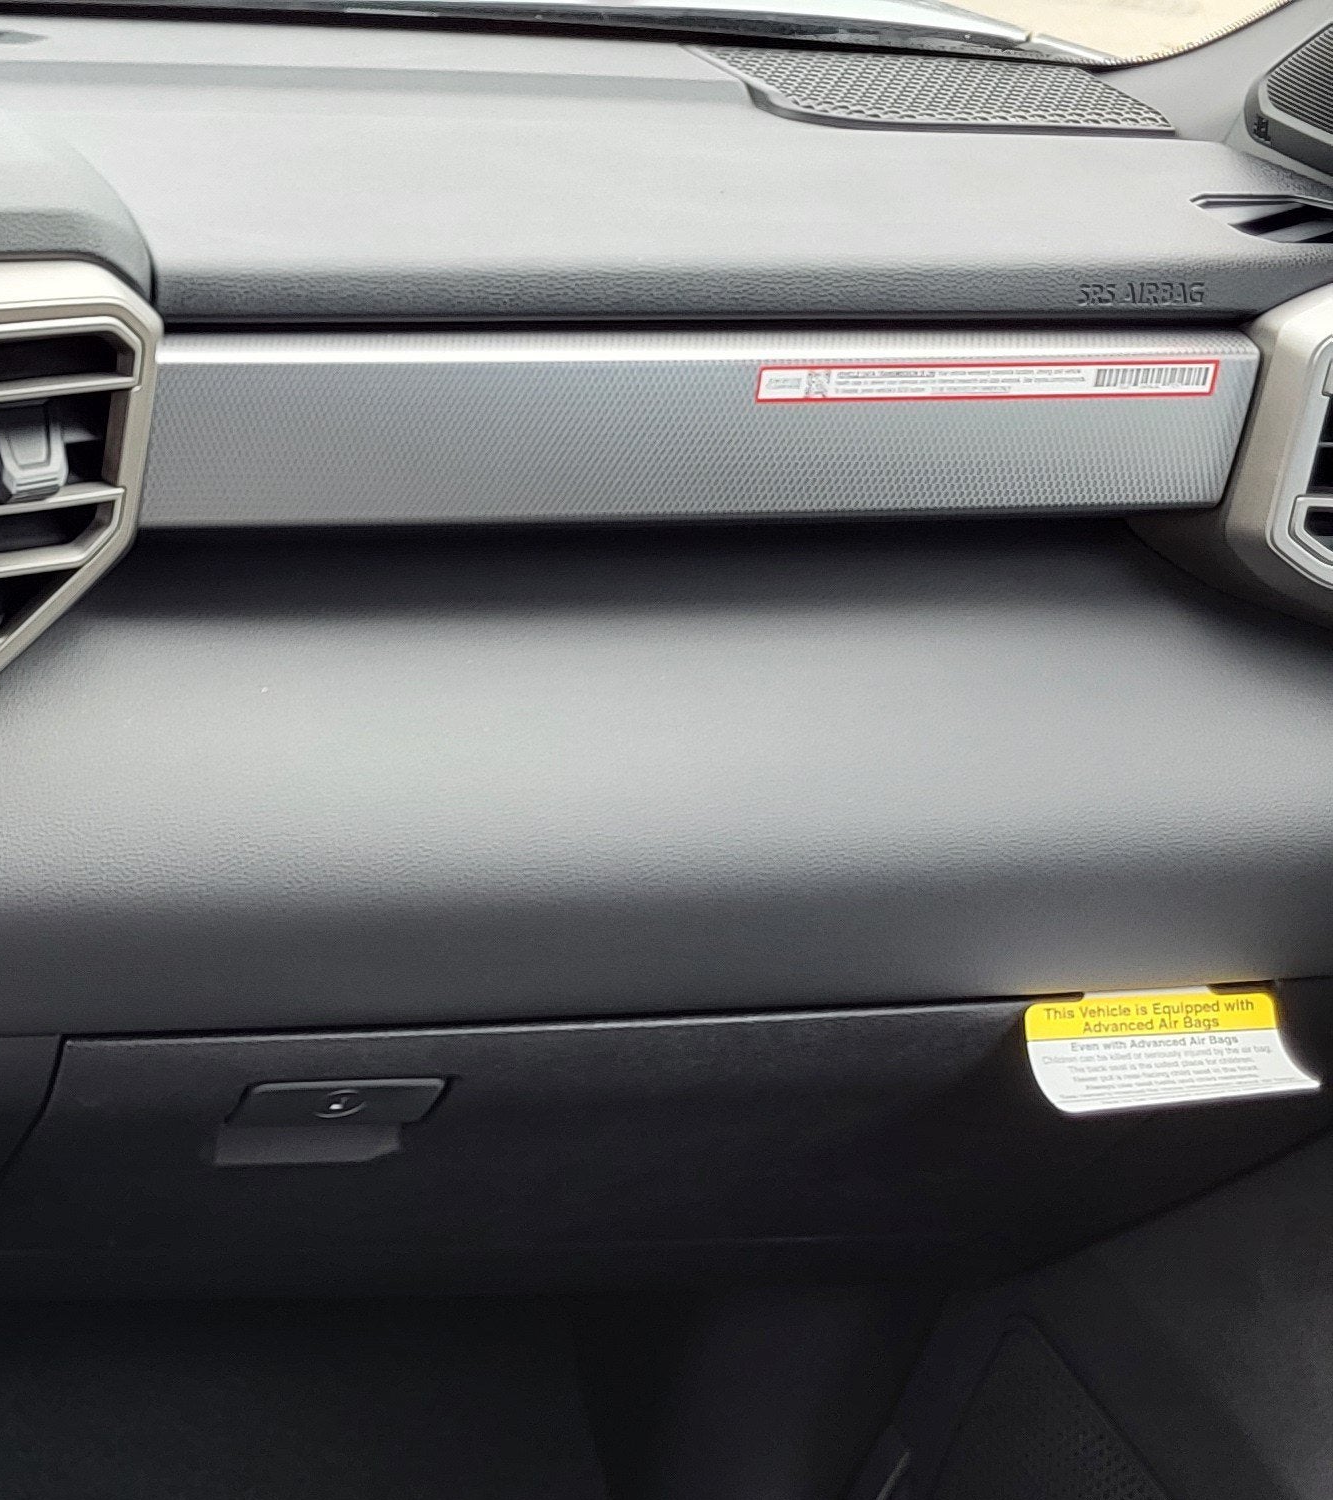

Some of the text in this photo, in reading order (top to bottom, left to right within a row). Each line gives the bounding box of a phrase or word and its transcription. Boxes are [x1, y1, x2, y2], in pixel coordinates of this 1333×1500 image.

[1078, 282, 1205, 306] SRS AIRBAG
[1044, 998, 1255, 1020] This Vehicle is Equipped with
[1082, 1015, 1220, 1034] Advanced Air Bags
[1070, 1034, 1239, 1053] Even with Advanced Air Bags
